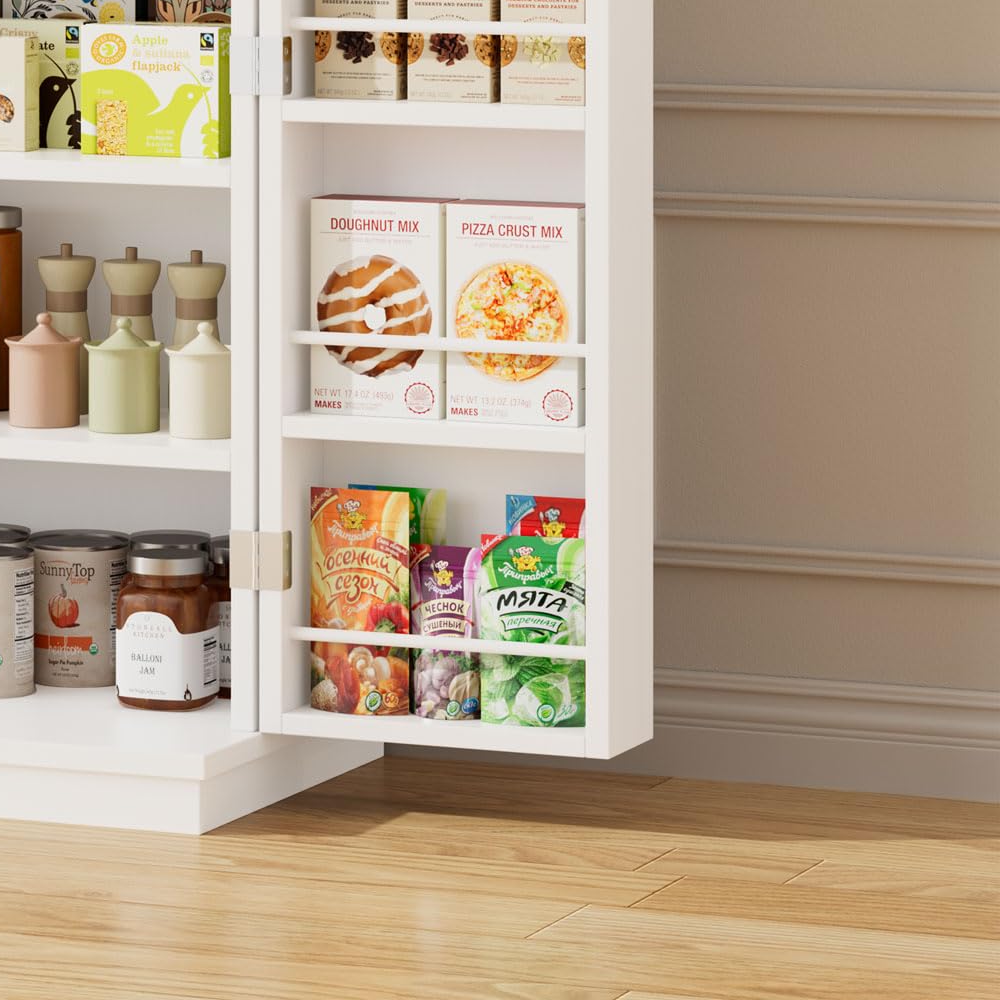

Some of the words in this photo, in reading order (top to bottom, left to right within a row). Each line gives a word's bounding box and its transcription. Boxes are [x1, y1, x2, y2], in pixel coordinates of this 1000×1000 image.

[132, 33, 169, 47] Apple
[132, 60, 181, 73] flapjack
[330, 217, 394, 232] DOUGHNUT
[398, 220, 419, 233] MIX
[461, 222, 494, 236] PIZZA
[498, 223, 537, 238] CRUST
[541, 225, 563, 239] MIX
[314, 387, 329, 397] NET
[330, 388, 341, 397] WT
[314, 400, 342, 409] MAKES
[450, 394, 466, 403] NET
[467, 395, 478, 403] WT
[450, 407, 479, 416] MAKES
[496, 590, 568, 613] МЯТА
[425, 602, 464, 614] ЧЕСНОК
[506, 615, 557, 629] перечная
[131, 652, 162, 663] BALLONI
[139, 666, 155, 675] JAM
